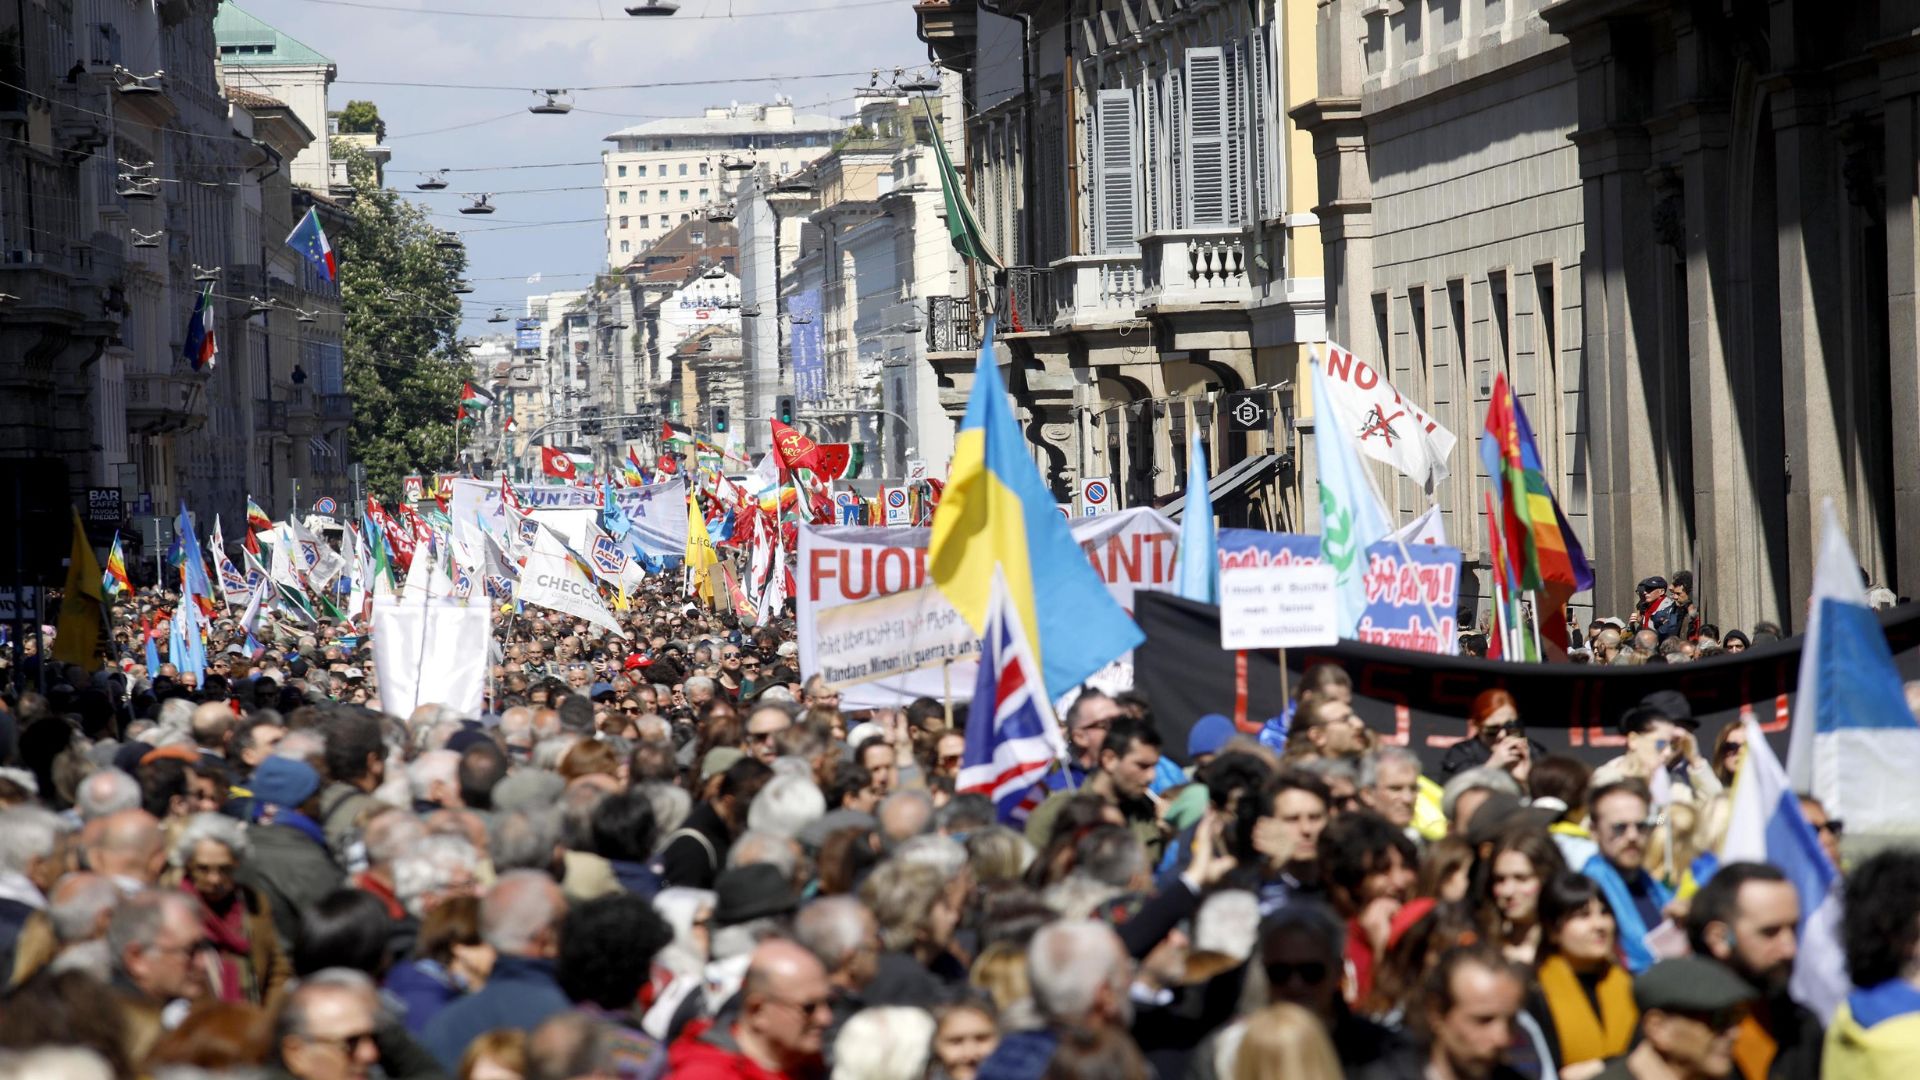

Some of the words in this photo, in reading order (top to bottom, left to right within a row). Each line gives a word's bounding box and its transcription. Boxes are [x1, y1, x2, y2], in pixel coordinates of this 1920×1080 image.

[1328, 349, 1378, 390] NO
[89, 490, 119, 500] BAR
[533, 489, 652, 506] UN'EUOPA
[597, 550, 623, 566] ACLI
